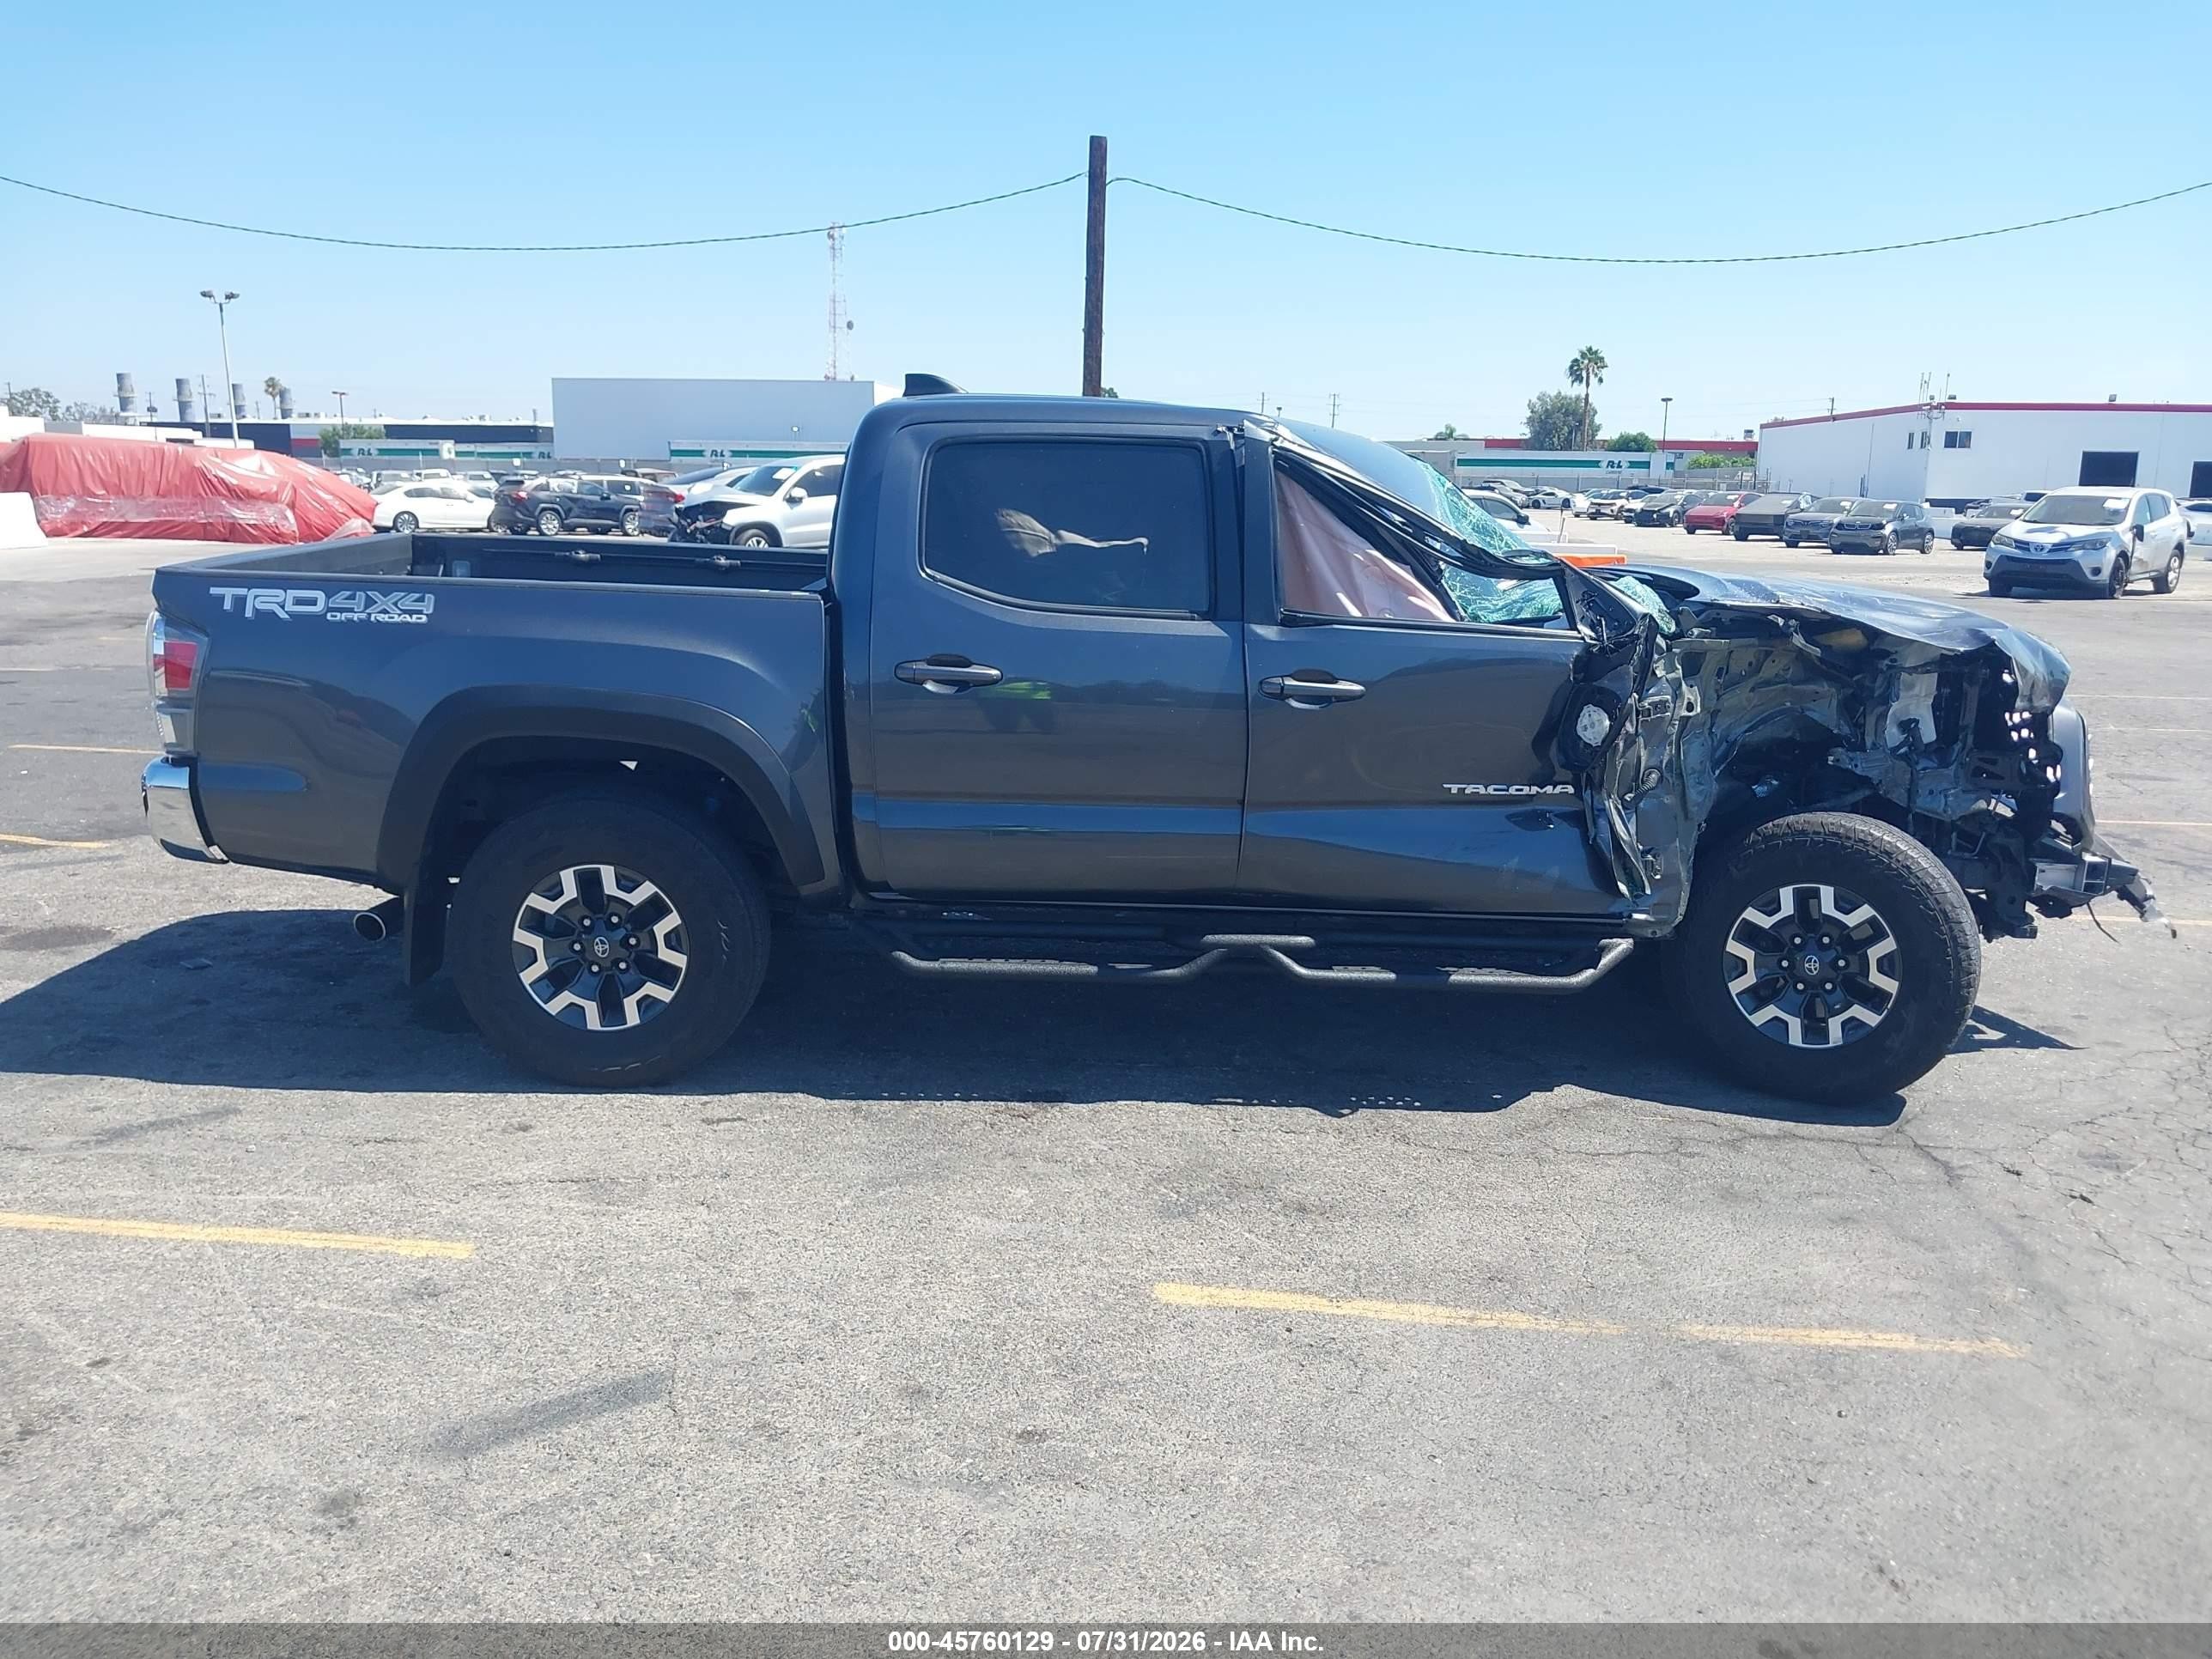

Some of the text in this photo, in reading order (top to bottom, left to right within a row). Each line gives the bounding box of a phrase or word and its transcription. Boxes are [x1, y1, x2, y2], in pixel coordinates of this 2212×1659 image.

[210, 586, 327, 621] TRD
[326, 612, 428, 623] OFF ROAD
[1442, 783, 1575, 795] TACOMA
